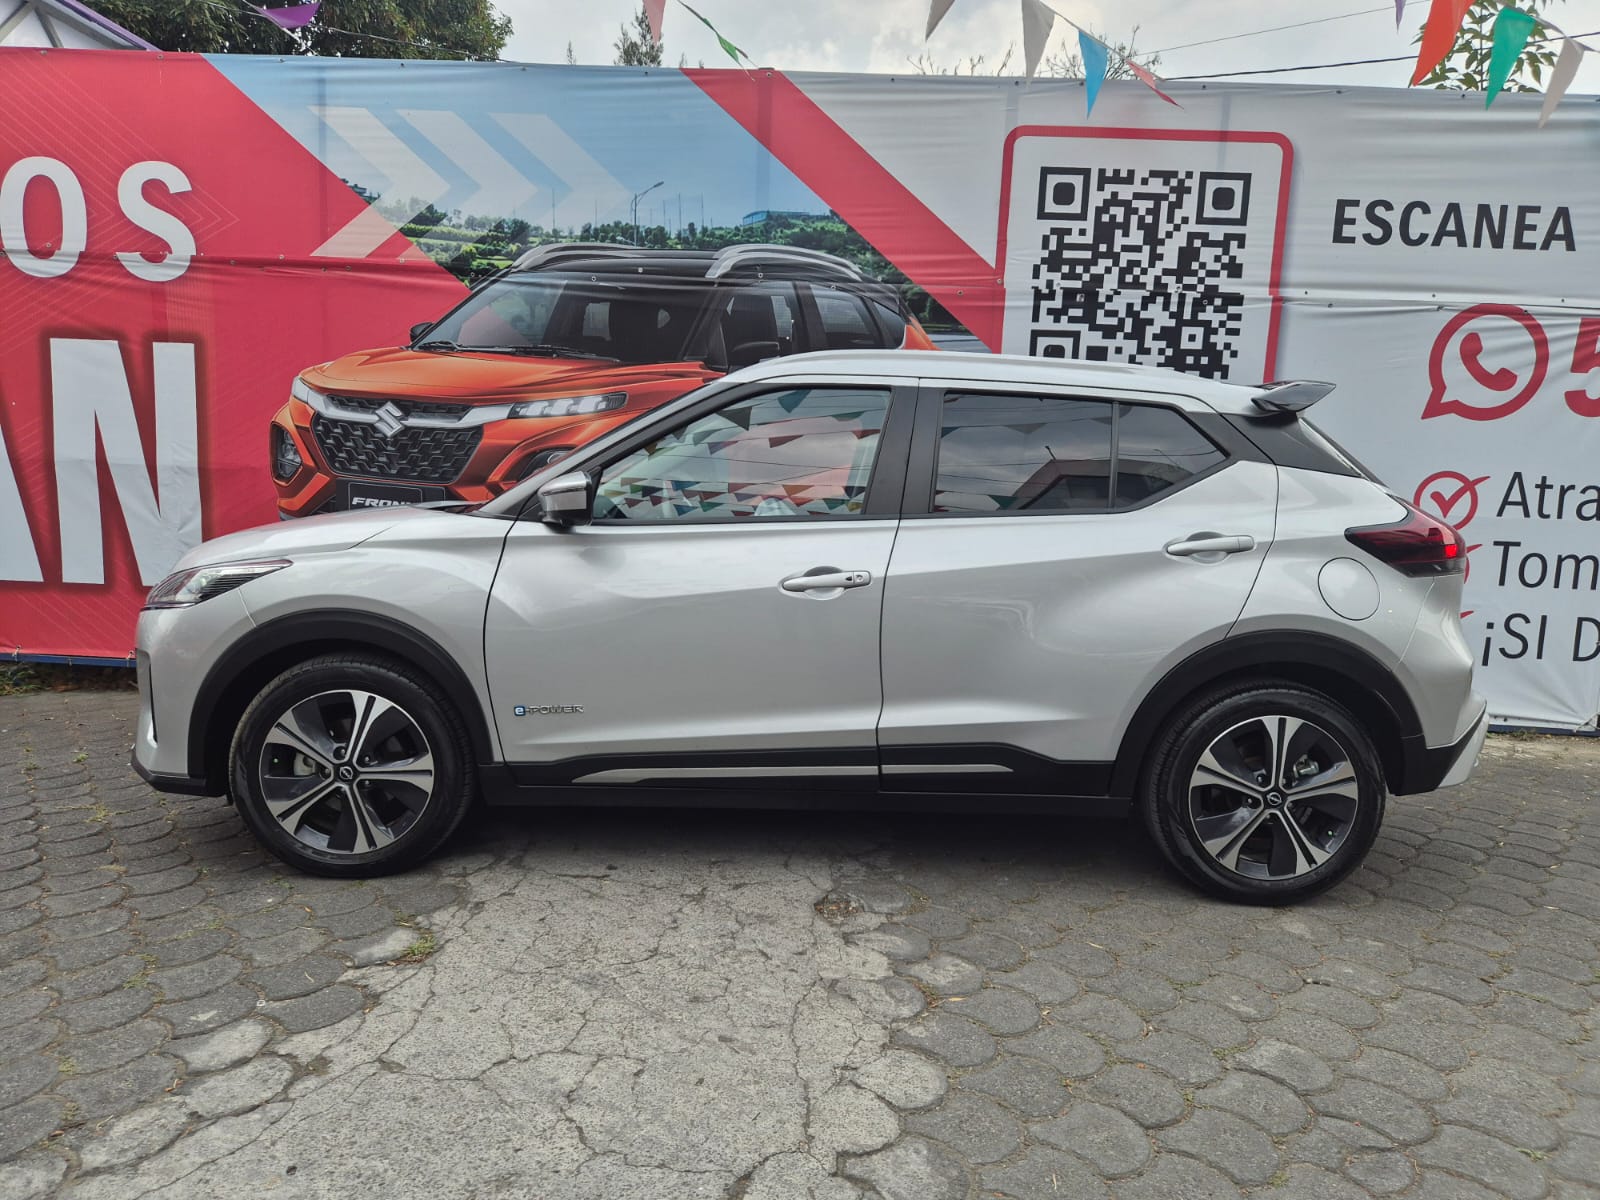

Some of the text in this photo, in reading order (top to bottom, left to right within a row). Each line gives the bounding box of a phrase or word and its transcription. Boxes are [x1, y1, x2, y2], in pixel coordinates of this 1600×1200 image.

[1332, 199, 1576, 251] ESCANEA
[1496, 471, 1600, 521] Atra
[1493, 541, 1600, 590] Tom
[1481, 613, 1548, 666] ¡SI
